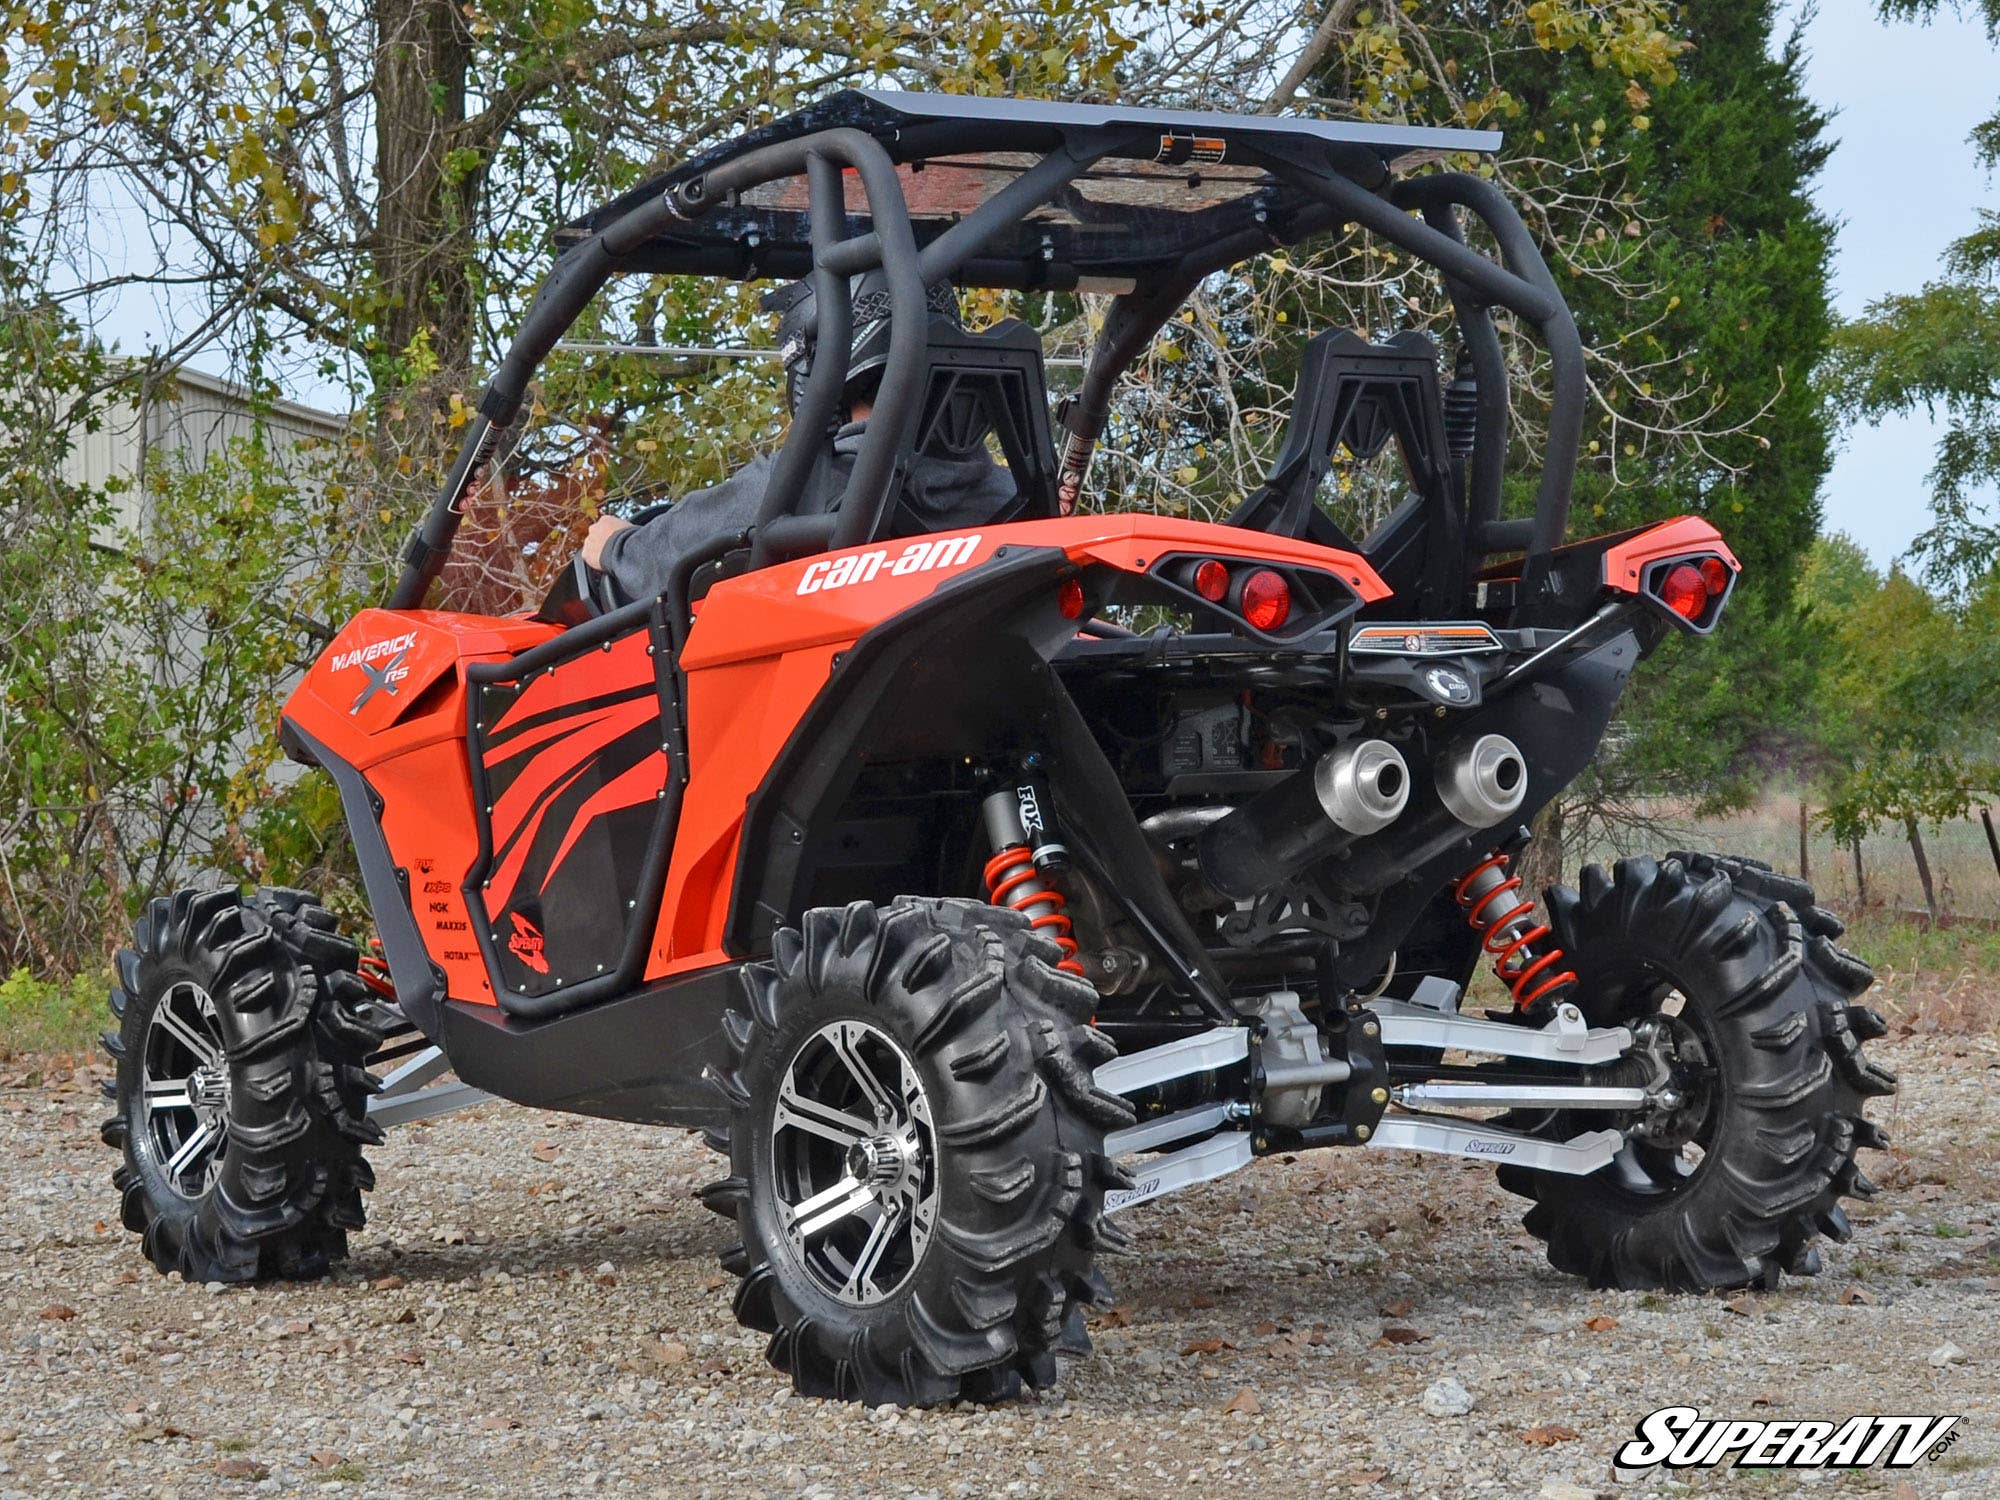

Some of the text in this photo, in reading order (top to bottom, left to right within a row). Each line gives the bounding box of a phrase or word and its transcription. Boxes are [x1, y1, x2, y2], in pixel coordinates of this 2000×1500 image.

[796, 534, 982, 596] can-am
[331, 631, 418, 672] MAVERICK
[384, 666, 410, 684] RS
[1017, 786, 1044, 834] FOX
[429, 902, 448, 913] NGK
[436, 922, 467, 931] MAXXIS
[444, 951, 470, 960] ROTAX
